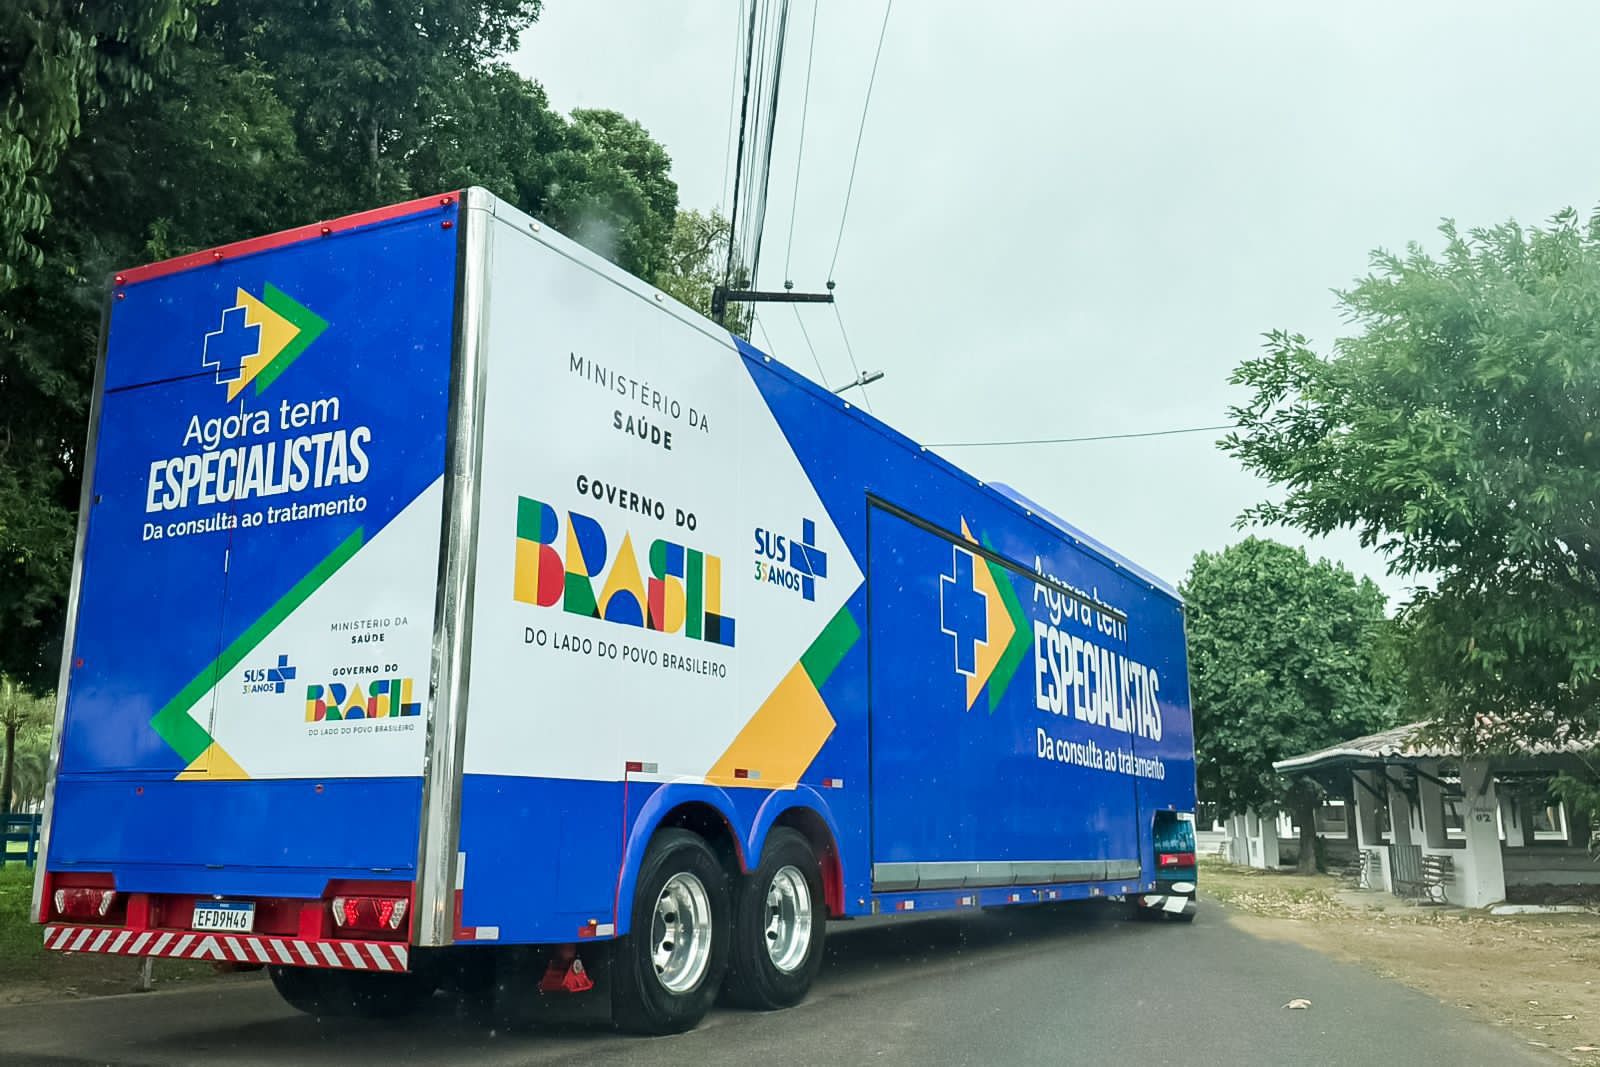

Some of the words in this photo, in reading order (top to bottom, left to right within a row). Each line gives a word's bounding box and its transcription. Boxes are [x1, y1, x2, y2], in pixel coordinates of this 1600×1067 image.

[570, 352, 680, 419] MINISTÉRIO
[689, 407, 709, 433] DA
[183, 409, 270, 451] Agora
[280, 396, 339, 430] tem
[613, 410, 672, 451] SAÚDE
[145, 426, 371, 513] ESPECIALISTAS
[143, 523, 163, 541] Da
[167, 514, 237, 538] consulta
[242, 511, 263, 528] ao
[268, 495, 367, 522] tratamento
[577, 475, 665, 521] GOVERNO
[676, 509, 697, 531] DO
[755, 527, 786, 562] SUS
[513, 495, 735, 648] BRASIL
[1034, 555, 1092, 626] Agora
[395, 616, 408, 626] DA
[243, 669, 265, 683] SUS
[332, 665, 379, 677] GOVERNO
[385, 663, 399, 673] DO
[525, 626, 547, 647] DO
[554, 631, 592, 655] LADO
[599, 640, 617, 660] DO
[623, 647, 657, 666] POVO
[663, 653, 726, 679] BRASILEIRO
[304, 677, 421, 723] BRASIL
[1033, 619, 1162, 742] ESPECIALISTAS
[1037, 727, 1054, 761] Da
[1056, 736, 1103, 769] consulta
[1104, 750, 1117, 773] ao
[1117, 747, 1165, 781] tratamento
[198, 910, 247, 928] EFD9H46
